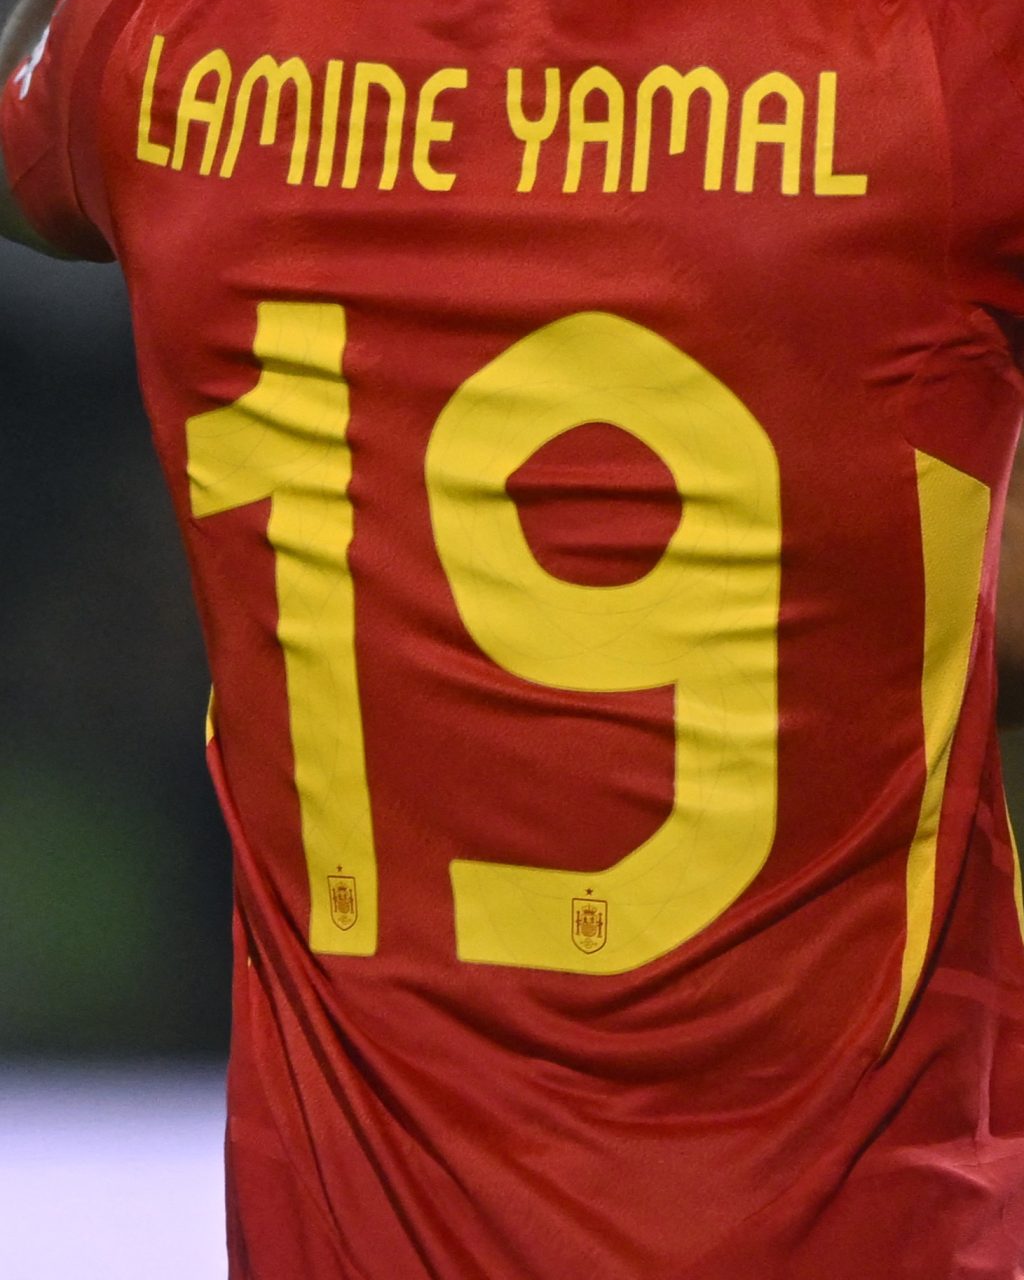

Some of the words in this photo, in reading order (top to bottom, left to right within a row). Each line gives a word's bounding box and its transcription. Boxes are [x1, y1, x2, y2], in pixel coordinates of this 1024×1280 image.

[137, 35, 468, 191] LAMINE
[507, 65, 868, 196] YAMAL
[186, 300, 781, 976] 19
